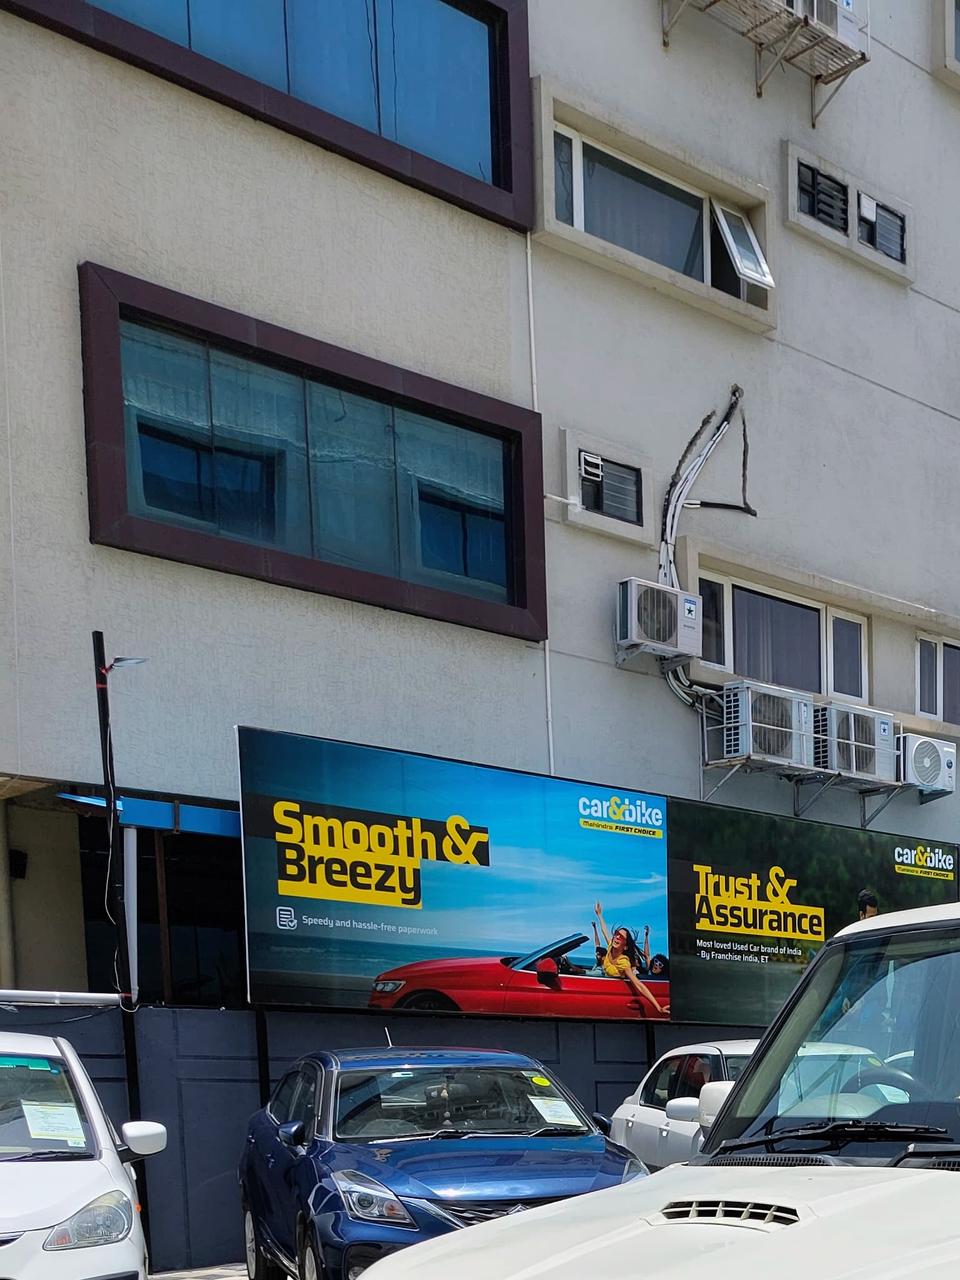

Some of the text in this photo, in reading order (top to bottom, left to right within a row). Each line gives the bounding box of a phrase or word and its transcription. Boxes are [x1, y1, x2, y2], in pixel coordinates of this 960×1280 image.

[578, 796, 663, 826] car&bike
[273, 800, 489, 865] Smooth &
[614, 824, 633, 833] FIRST
[634, 828, 656, 836] CHOICE
[894, 845, 954, 870] car&bike
[277, 842, 422, 906] Breezy
[693, 864, 797, 904] Trust &
[302, 915, 439, 935] Speedy and hassle-free paperwork
[696, 895, 822, 936] Assurance
[696, 939, 802, 956] Most loved Used Car brand of India
[701, 951, 710, 960] By
[711, 951, 742, 962] Franchise
[742, 954, 760, 963] India,
[760, 955, 769, 963] ET
